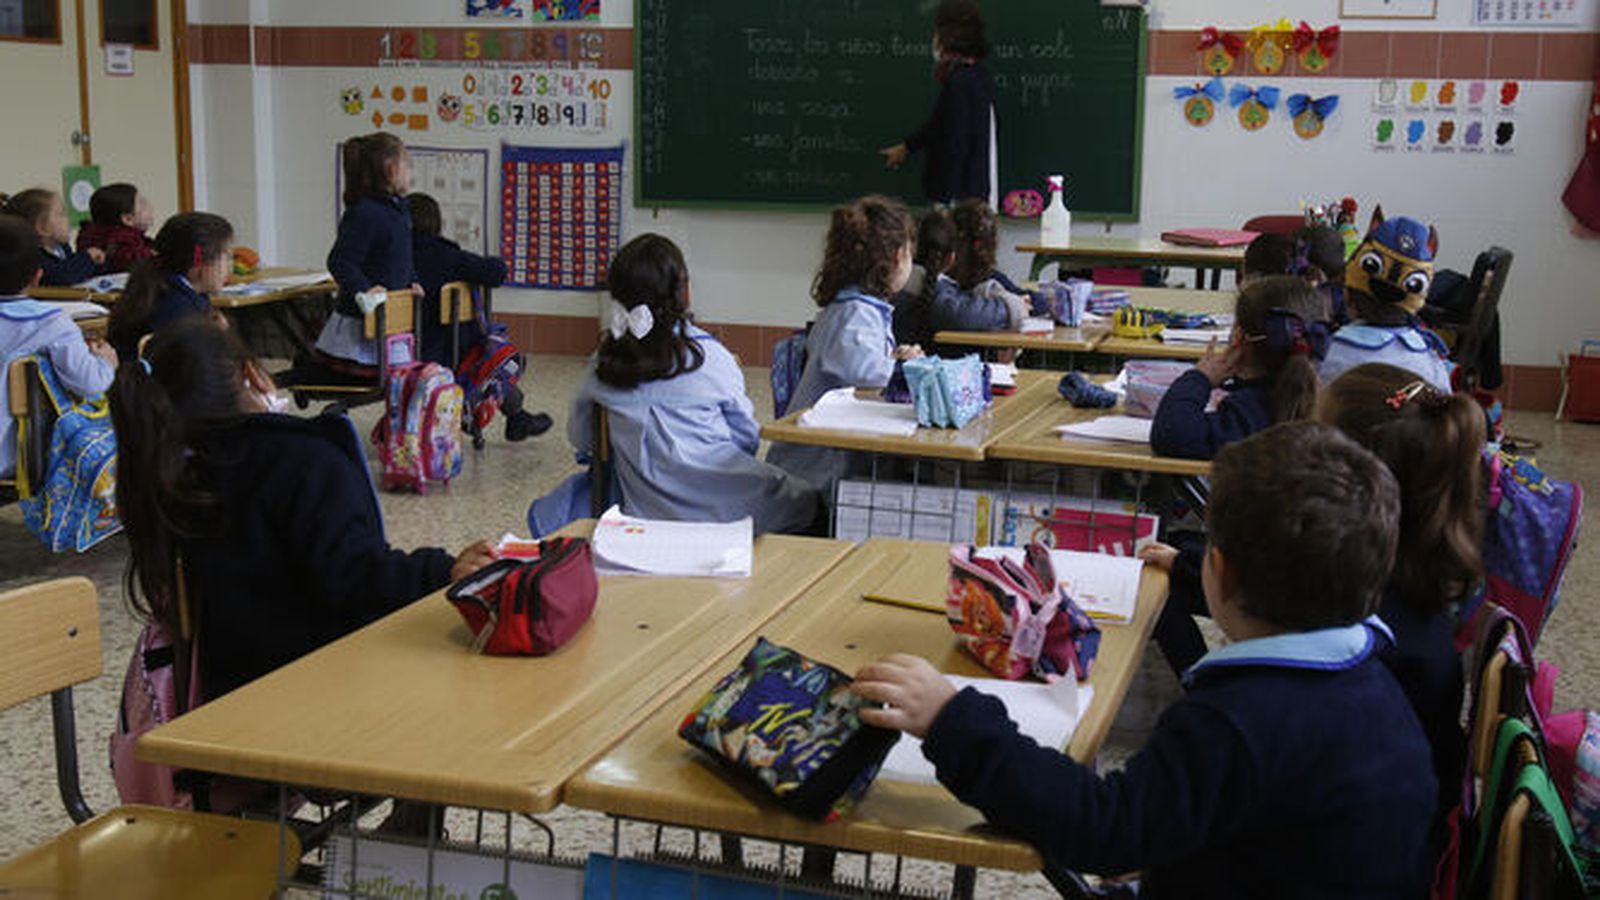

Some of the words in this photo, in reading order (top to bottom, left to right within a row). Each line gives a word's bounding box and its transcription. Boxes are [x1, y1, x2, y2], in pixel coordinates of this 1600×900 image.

[381, 33, 391, 57] 1
[400, 32, 416, 58] 2
[421, 32, 437, 58] 3
[464, 30, 480, 58] 5
[507, 32, 525, 58] 7
[531, 32, 547, 59] 8
[552, 33, 568, 59] 9
[577, 32, 604, 58] 10
[463, 74, 477, 95] 0
[511, 74, 524, 95] 2
[535, 75, 548, 95] 3
[587, 79, 611, 99] 10
[463, 105, 476, 125] 5
[487, 105, 500, 125] 6
[512, 105, 525, 126] 7
[537, 105, 550, 126] 8
[562, 105, 575, 126] 9
